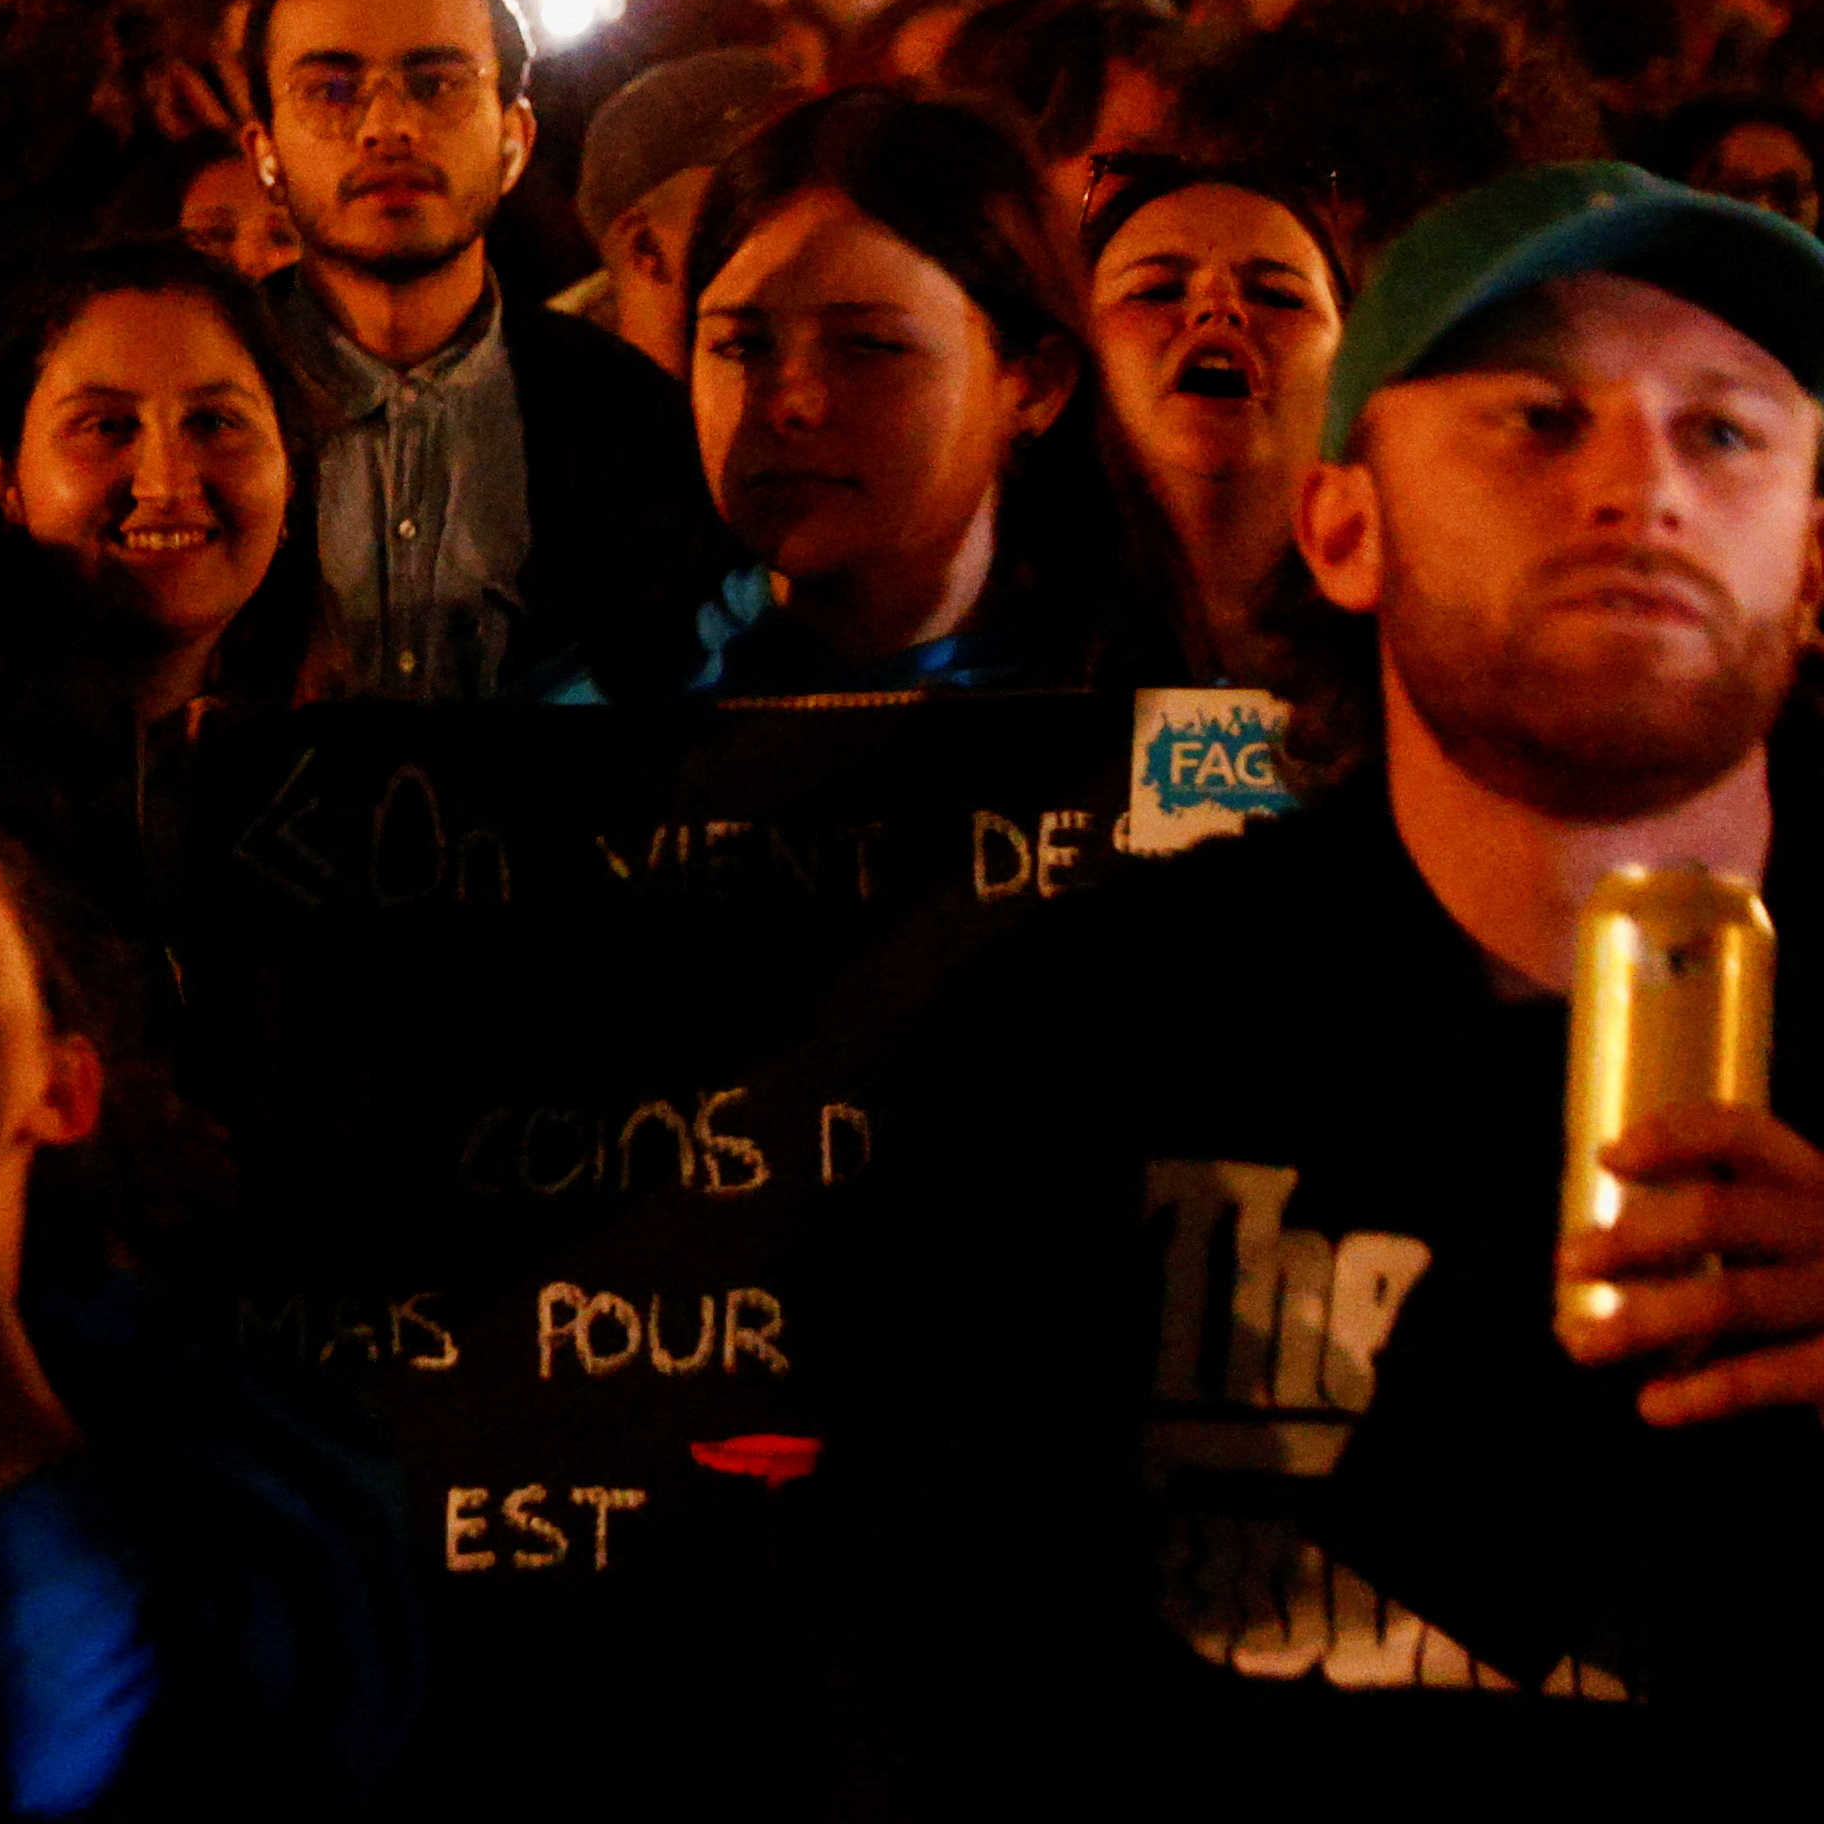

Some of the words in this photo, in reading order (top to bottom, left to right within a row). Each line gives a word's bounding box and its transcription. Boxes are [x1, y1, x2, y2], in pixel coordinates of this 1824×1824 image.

[1169, 740, 1276, 788] FAG
[970, 806, 1132, 902] DE
[534, 1280, 792, 1378] POUR
[444, 1482, 650, 1572] EST
